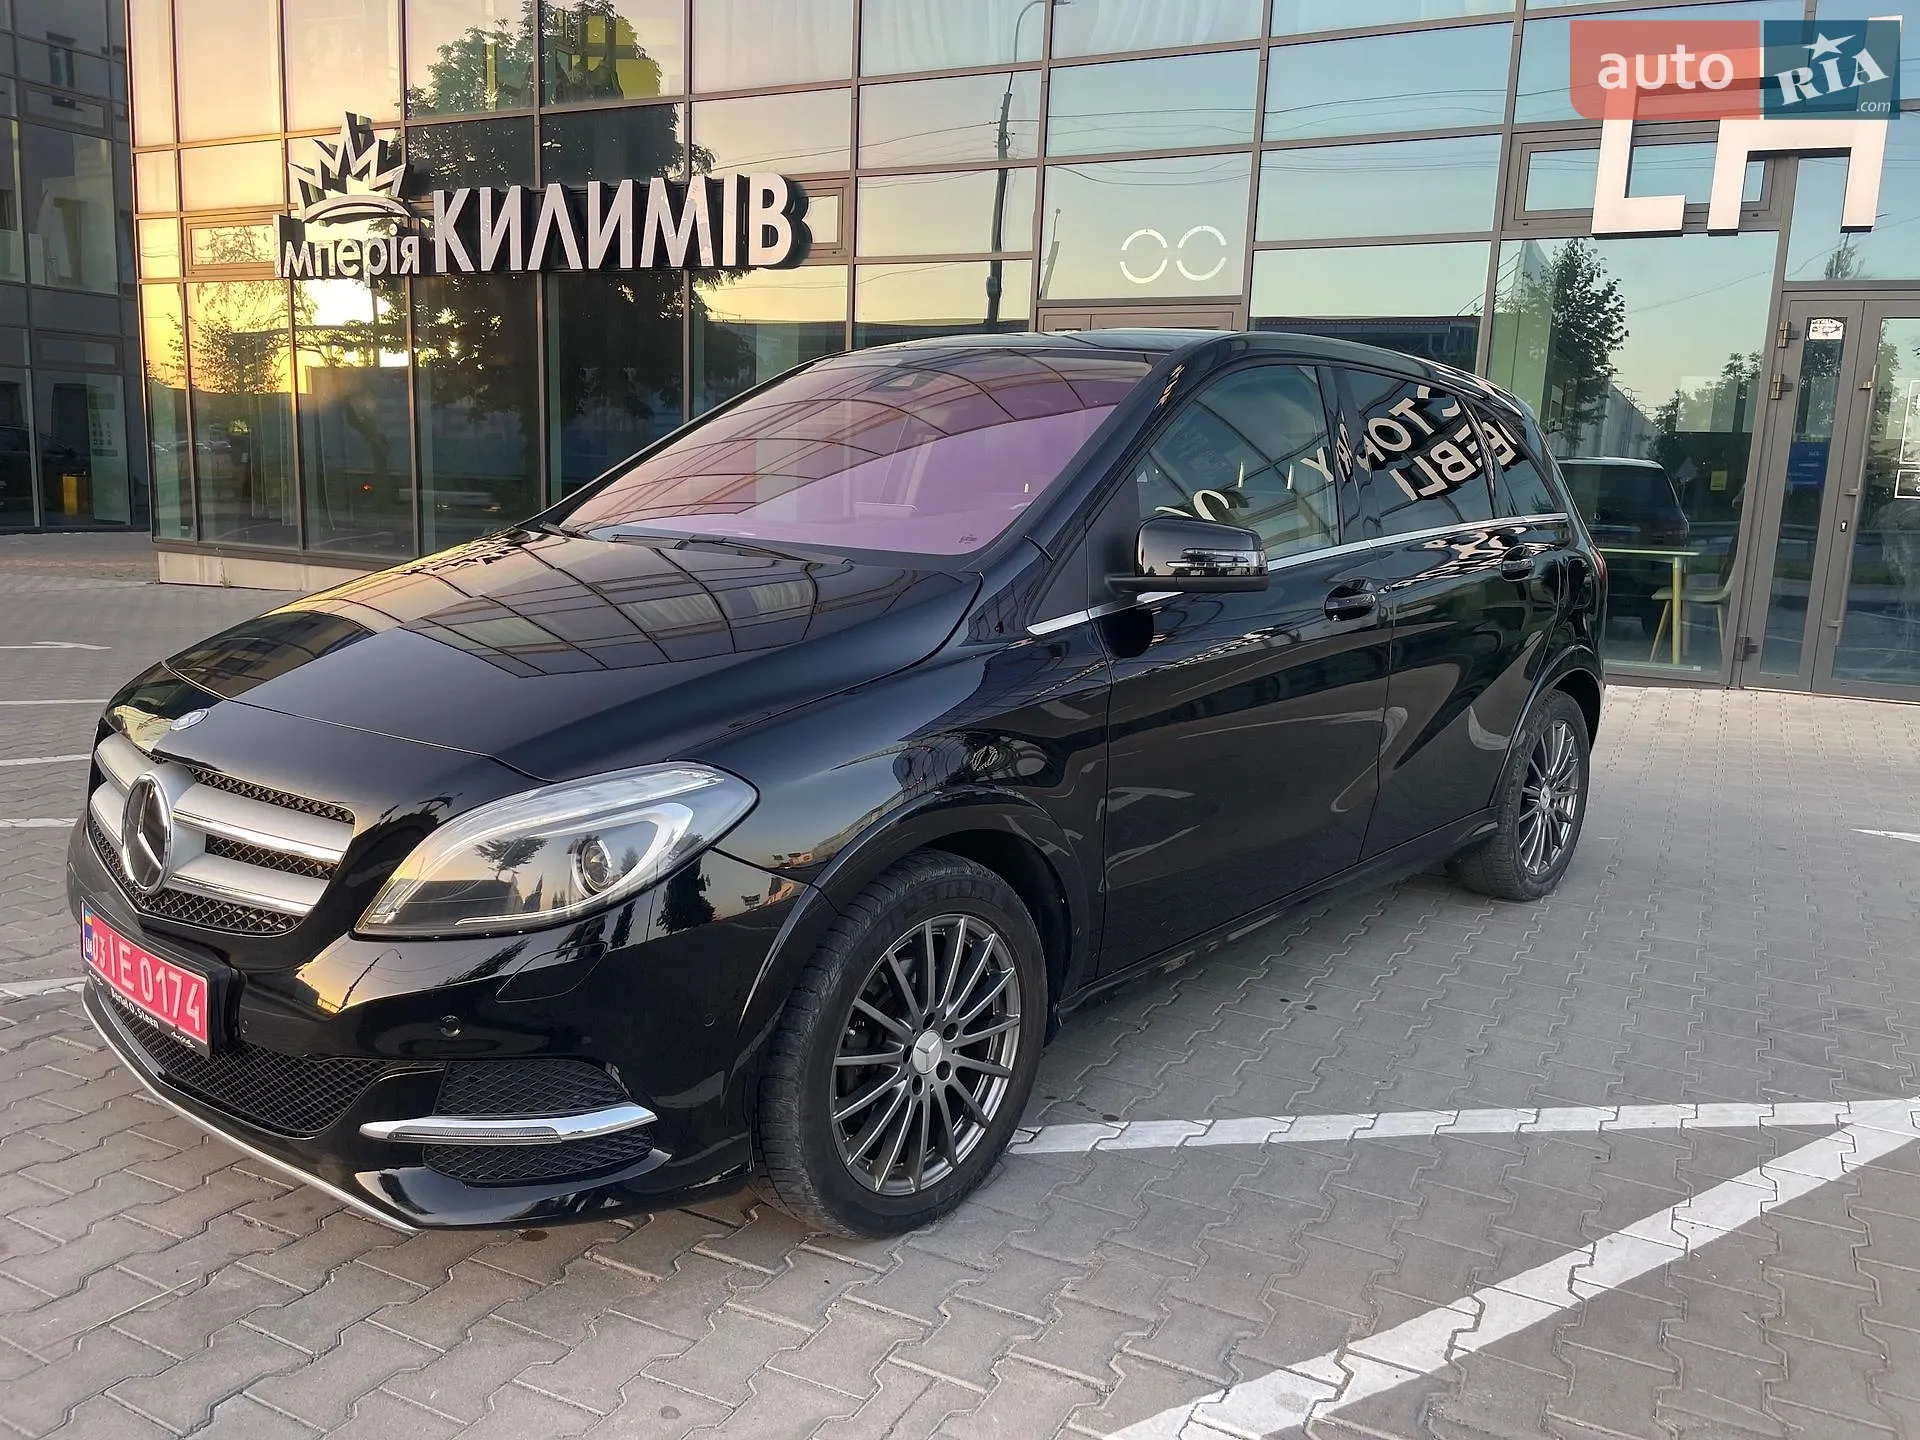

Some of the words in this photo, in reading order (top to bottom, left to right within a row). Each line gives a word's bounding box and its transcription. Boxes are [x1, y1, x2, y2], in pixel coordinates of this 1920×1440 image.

[433, 172, 793, 272] КИЛИМІВ
[92, 931, 107, 969] 03
[139, 956, 201, 1032] 0174
